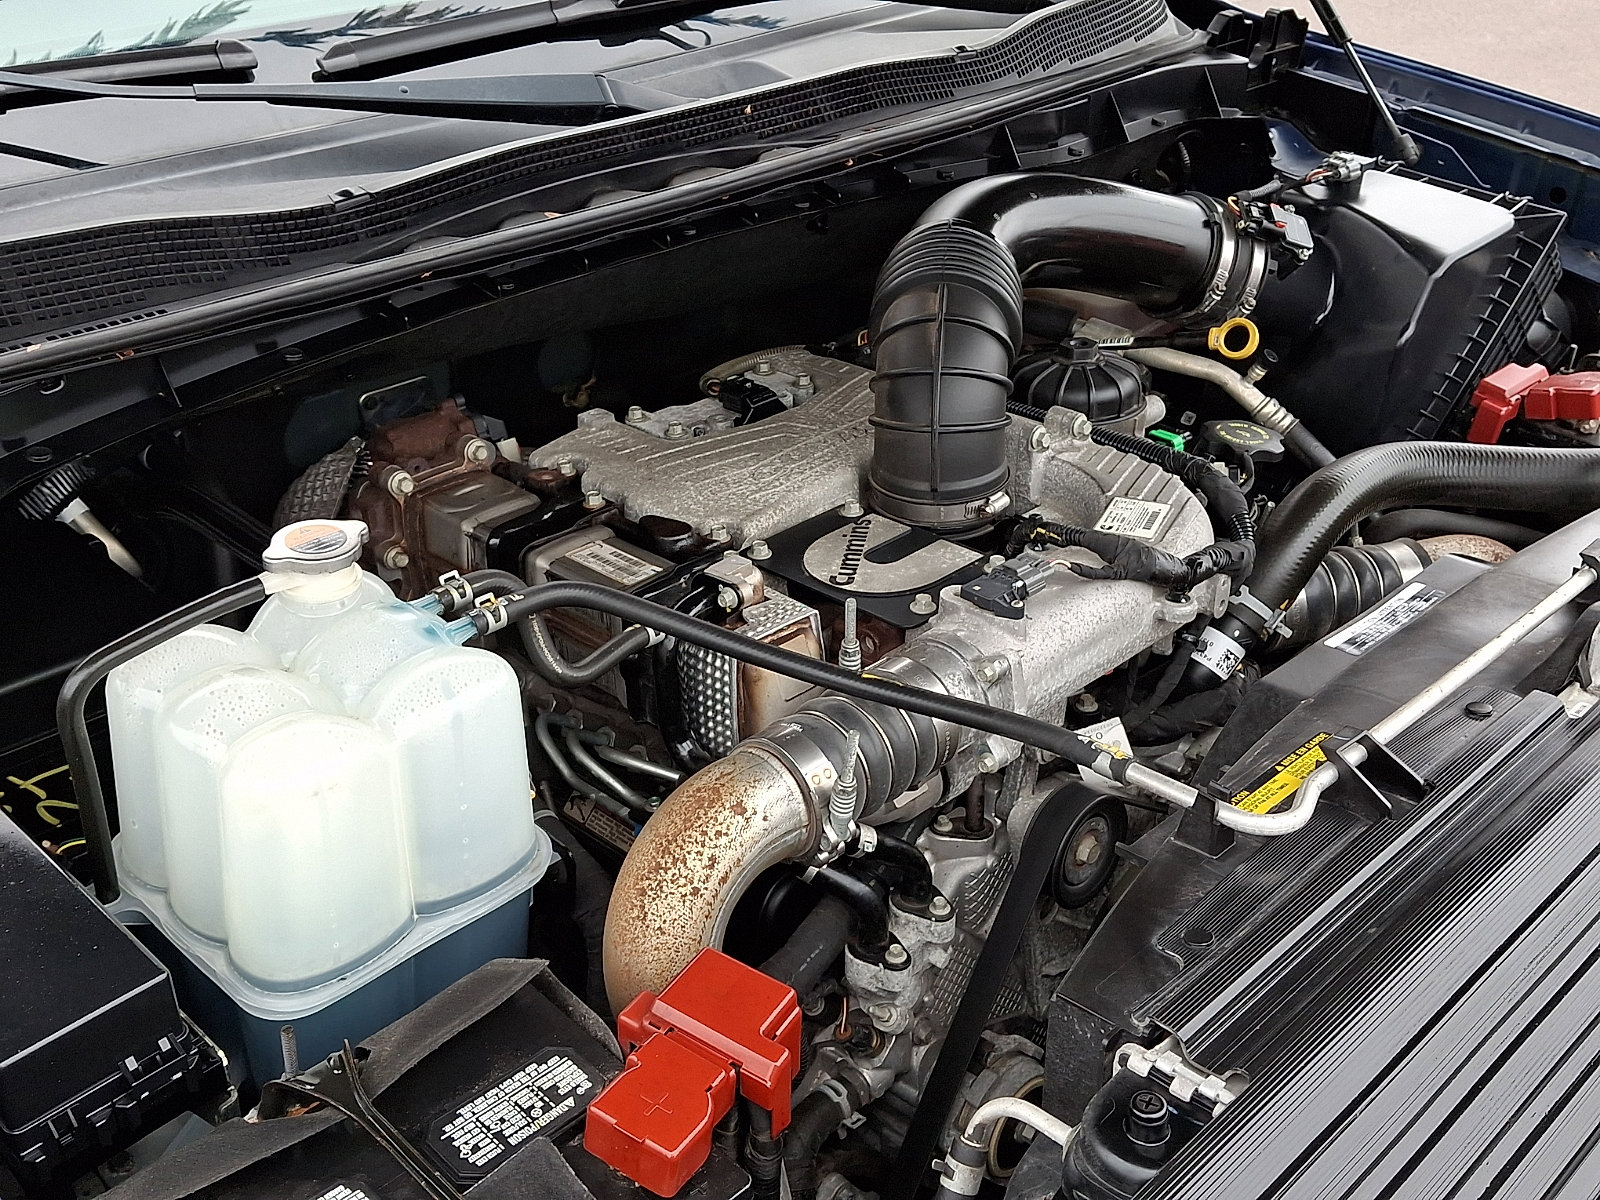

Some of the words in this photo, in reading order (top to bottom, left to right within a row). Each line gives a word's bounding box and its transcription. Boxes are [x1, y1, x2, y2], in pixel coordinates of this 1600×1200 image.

[829, 519, 872, 585] Cummins
[1297, 745, 1309, 755] EN
[1230, 789, 1250, 806] TION
